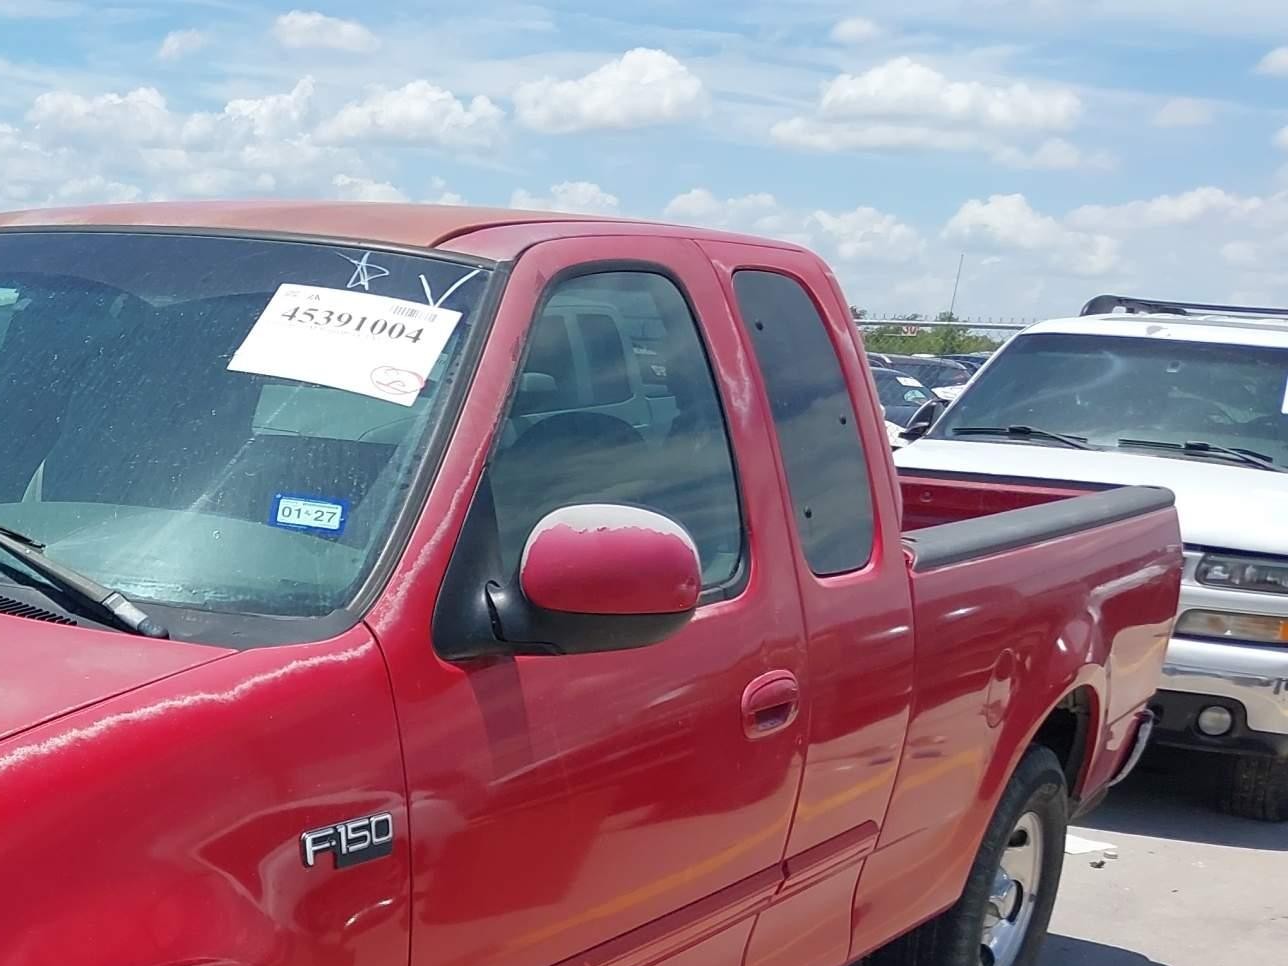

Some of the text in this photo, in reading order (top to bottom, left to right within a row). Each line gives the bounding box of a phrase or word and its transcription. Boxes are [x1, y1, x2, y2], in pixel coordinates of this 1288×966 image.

[281, 306, 424, 343] 45391004
[313, 509, 337, 523] 27
[301, 813, 393, 866] F-150
